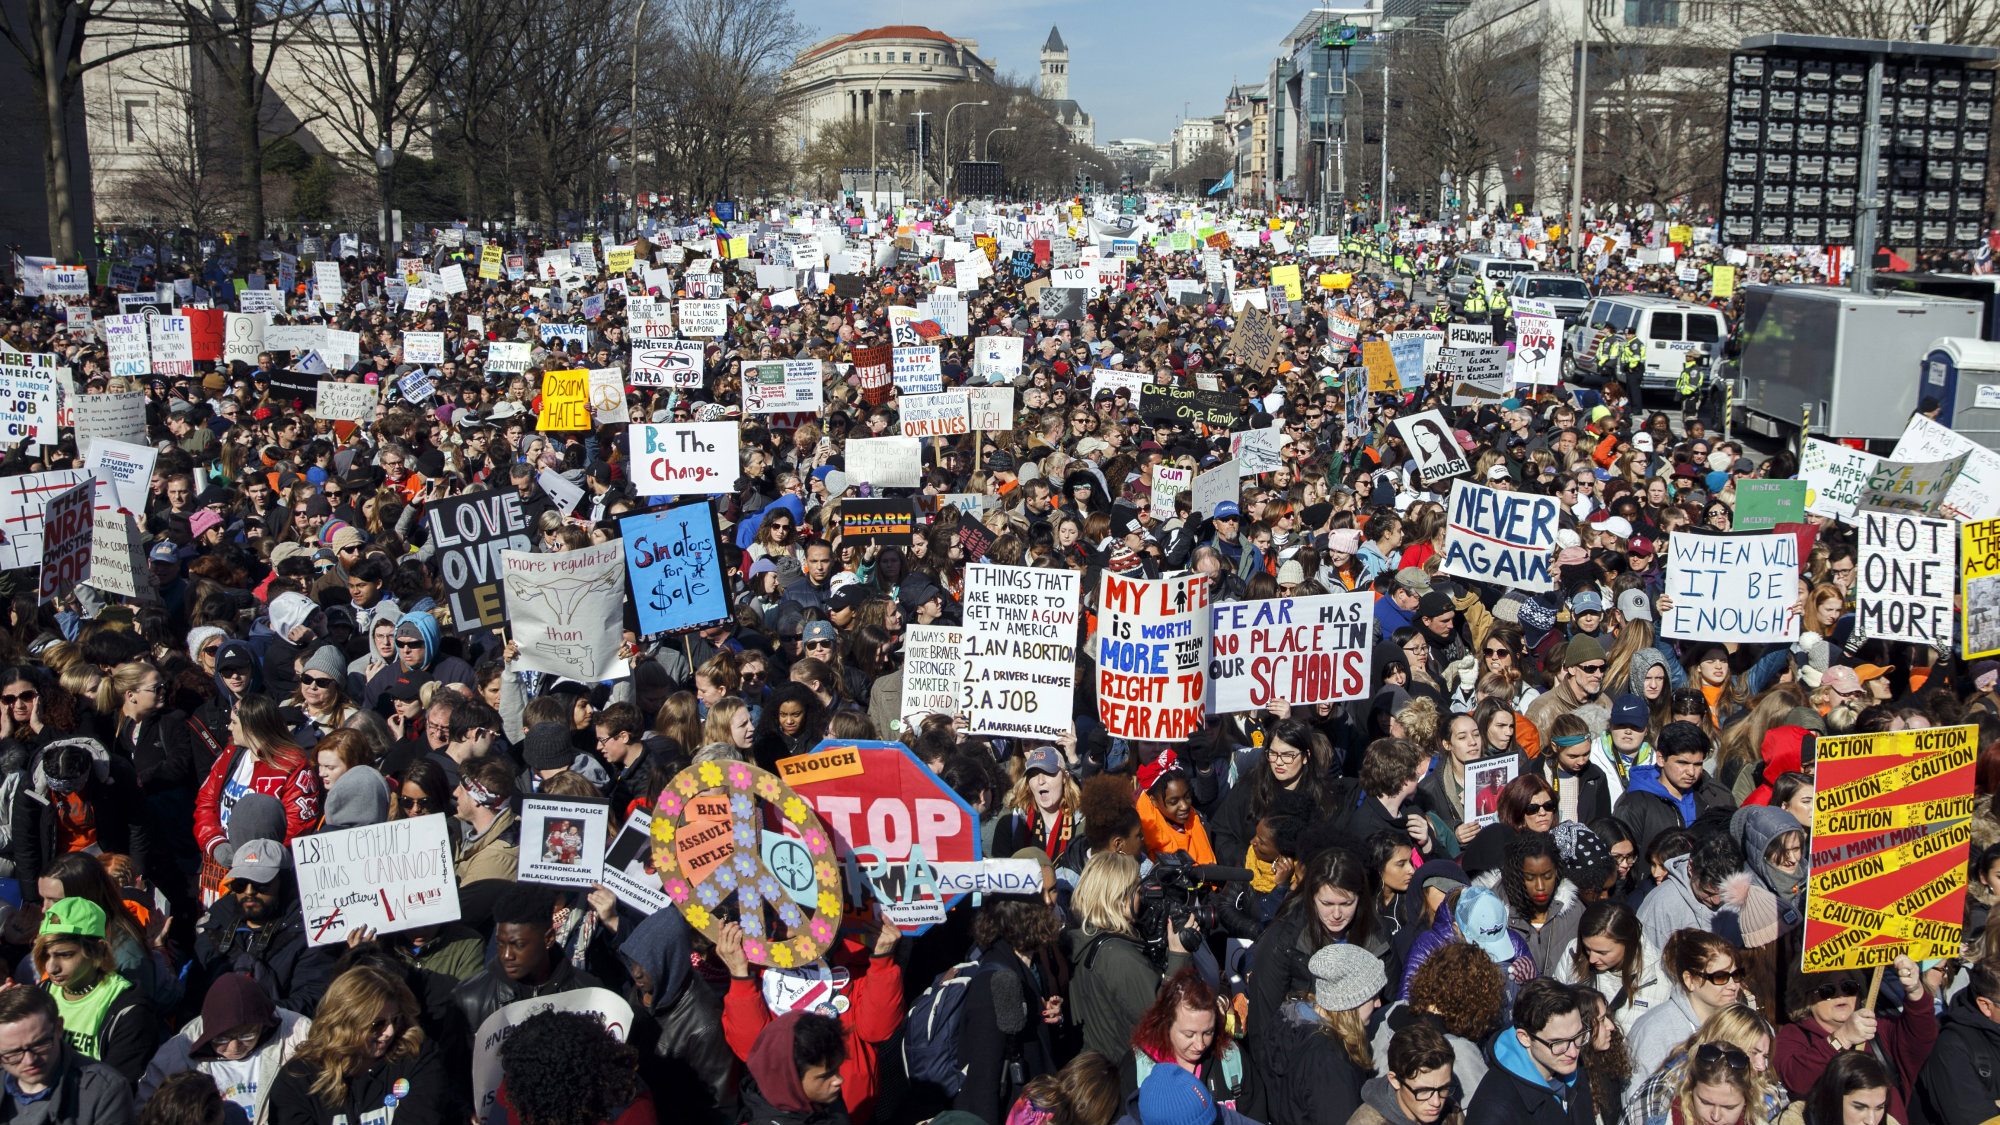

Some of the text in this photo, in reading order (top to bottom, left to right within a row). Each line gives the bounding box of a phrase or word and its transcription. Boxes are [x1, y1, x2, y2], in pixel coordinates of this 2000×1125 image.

[1001, 222, 1022, 240] NRA
[1018, 251, 1032, 260] UCF
[57, 273, 75, 283] NOT
[686, 273, 711, 282] PROTECT
[1012, 267, 1031, 278] MSD
[686, 283, 705, 298] NOT
[1041, 290, 1053, 301] WE
[1053, 302, 1065, 314] BS
[122, 315, 144, 324] BLACK
[163, 318, 185, 332] LIFE
[697, 318, 725, 326] ASSAULT
[1520, 320, 1549, 328] HUNTING
[107, 325, 133, 334] WOMAN
[541, 324, 587, 336] #NEVER
[645, 325, 670, 337] PTSD
[896, 327, 916, 342] BS!
[1451, 328, 1492, 342] #ENOUGH
[1518, 327, 1543, 336] SEASON
[229, 344, 260, 354] SHOOT
[908, 347, 936, 355] HAPPENED
[1259, 329, 1276, 361] VOTE
[1523, 335, 1554, 350] OVER
[39, 354, 53, 368] IN
[114, 361, 145, 375] GUNS
[487, 359, 530, 370] FORTNITE
[1469, 356, 1492, 364] GLOCK
[635, 372, 661, 382] NRA
[674, 372, 699, 383] GOP
[909, 373, 941, 382] PURSUIT
[1467, 372, 1503, 380] CLASSROOM
[15, 381, 50, 392] HARDER
[17, 390, 37, 400] GET
[546, 375, 587, 398] Disarm
[1143, 382, 1195, 399] One Team
[9, 400, 37, 415] JOB
[928, 395, 965, 408] POLITICS
[0, 413, 25, 423] THAN
[548, 400, 587, 428] HATE
[1177, 405, 1239, 427] One Family
[8, 423, 38, 438] GUN
[904, 416, 967, 437] OUR LIVES
[676, 430, 715, 453] The
[101, 458, 144, 471] STUDENTS
[651, 458, 719, 482] Change.
[1422, 460, 1467, 480] ENOUGH
[1848, 455, 1866, 468] IT
[1877, 462, 1914, 479] WE
[1834, 479, 1850, 491] AT
[52, 485, 89, 516] THE
[917, 495, 946, 513] WE
[429, 491, 525, 548] LOVE
[845, 512, 912, 526] DISARM
[1454, 486, 1556, 545] NEVER
[43, 501, 94, 549] NRA
[1866, 513, 1948, 554] NOT
[43, 538, 74, 565] OWNS
[1673, 532, 1799, 568] WHEN WILL
[508, 549, 618, 573] more regulated
[1445, 540, 1552, 583] AGAIN
[41, 547, 91, 598] GOP
[664, 564, 684, 580] for
[970, 567, 1074, 591] THINGS THAT
[1865, 552, 1942, 598] ONE
[1679, 569, 1784, 601] IT BE
[968, 591, 1065, 608] ARE HARDER TO
[1105, 576, 1149, 616] MY
[966, 605, 1074, 624] GET THAN GUN
[1214, 599, 1361, 630] FEAR HAS
[1673, 605, 1794, 637] ENOUGH?
[1860, 598, 1948, 641] MORE
[547, 627, 583, 642] than
[911, 631, 946, 644] ALWAYS
[980, 621, 1058, 638] IN AMERICA
[1142, 619, 1192, 639] WORTH
[1213, 622, 1367, 657] NO PLACE IN
[930, 646, 961, 661] BRAVER
[985, 639, 1076, 663] AN ABORTION
[1100, 636, 1203, 674] MORE THAN
[1175, 650, 1200, 665] YOUR
[909, 661, 956, 676] STRONGER
[908, 677, 949, 692] SMARTER
[994, 670, 1071, 688] DRIVERS LICENSE
[1101, 669, 1204, 703] RIGHT TO
[1209, 650, 1364, 706] OUR SCHOOLS
[907, 695, 952, 708] AND LOVED
[998, 690, 1038, 713] JOB
[987, 720, 1032, 733] MARRIAGE
[1100, 701, 1206, 739] BEAR ARMS
[1916, 730, 1967, 751] ACTION
[784, 752, 856, 776] ENOUGH
[1497, 757, 1515, 765] POLICE
[1911, 746, 1974, 782] CAUTION
[1817, 779, 1882, 812] CAUTION
[528, 804, 559, 812] DISARM
[575, 807, 603, 815] POLICE
[698, 804, 728, 815] BAN
[1829, 811, 1892, 833] CAUTION
[678, 820, 733, 852] ASSAULT
[1812, 824, 1929, 868] HOW MANY MORE
[688, 843, 734, 870] RIFLES
[314, 849, 439, 892] laws CANNOT
[530, 864, 592, 874] #STEPHONCLARK
[521, 873, 599, 884] #BLACKLIVESMATTER
[604, 867, 666, 902] #PHILANDOCASTILE
[939, 873, 1038, 890] AGENDA
[333, 891, 378, 909] century
[911, 903, 939, 912] taking
[1823, 903, 1886, 931] CAUTION
